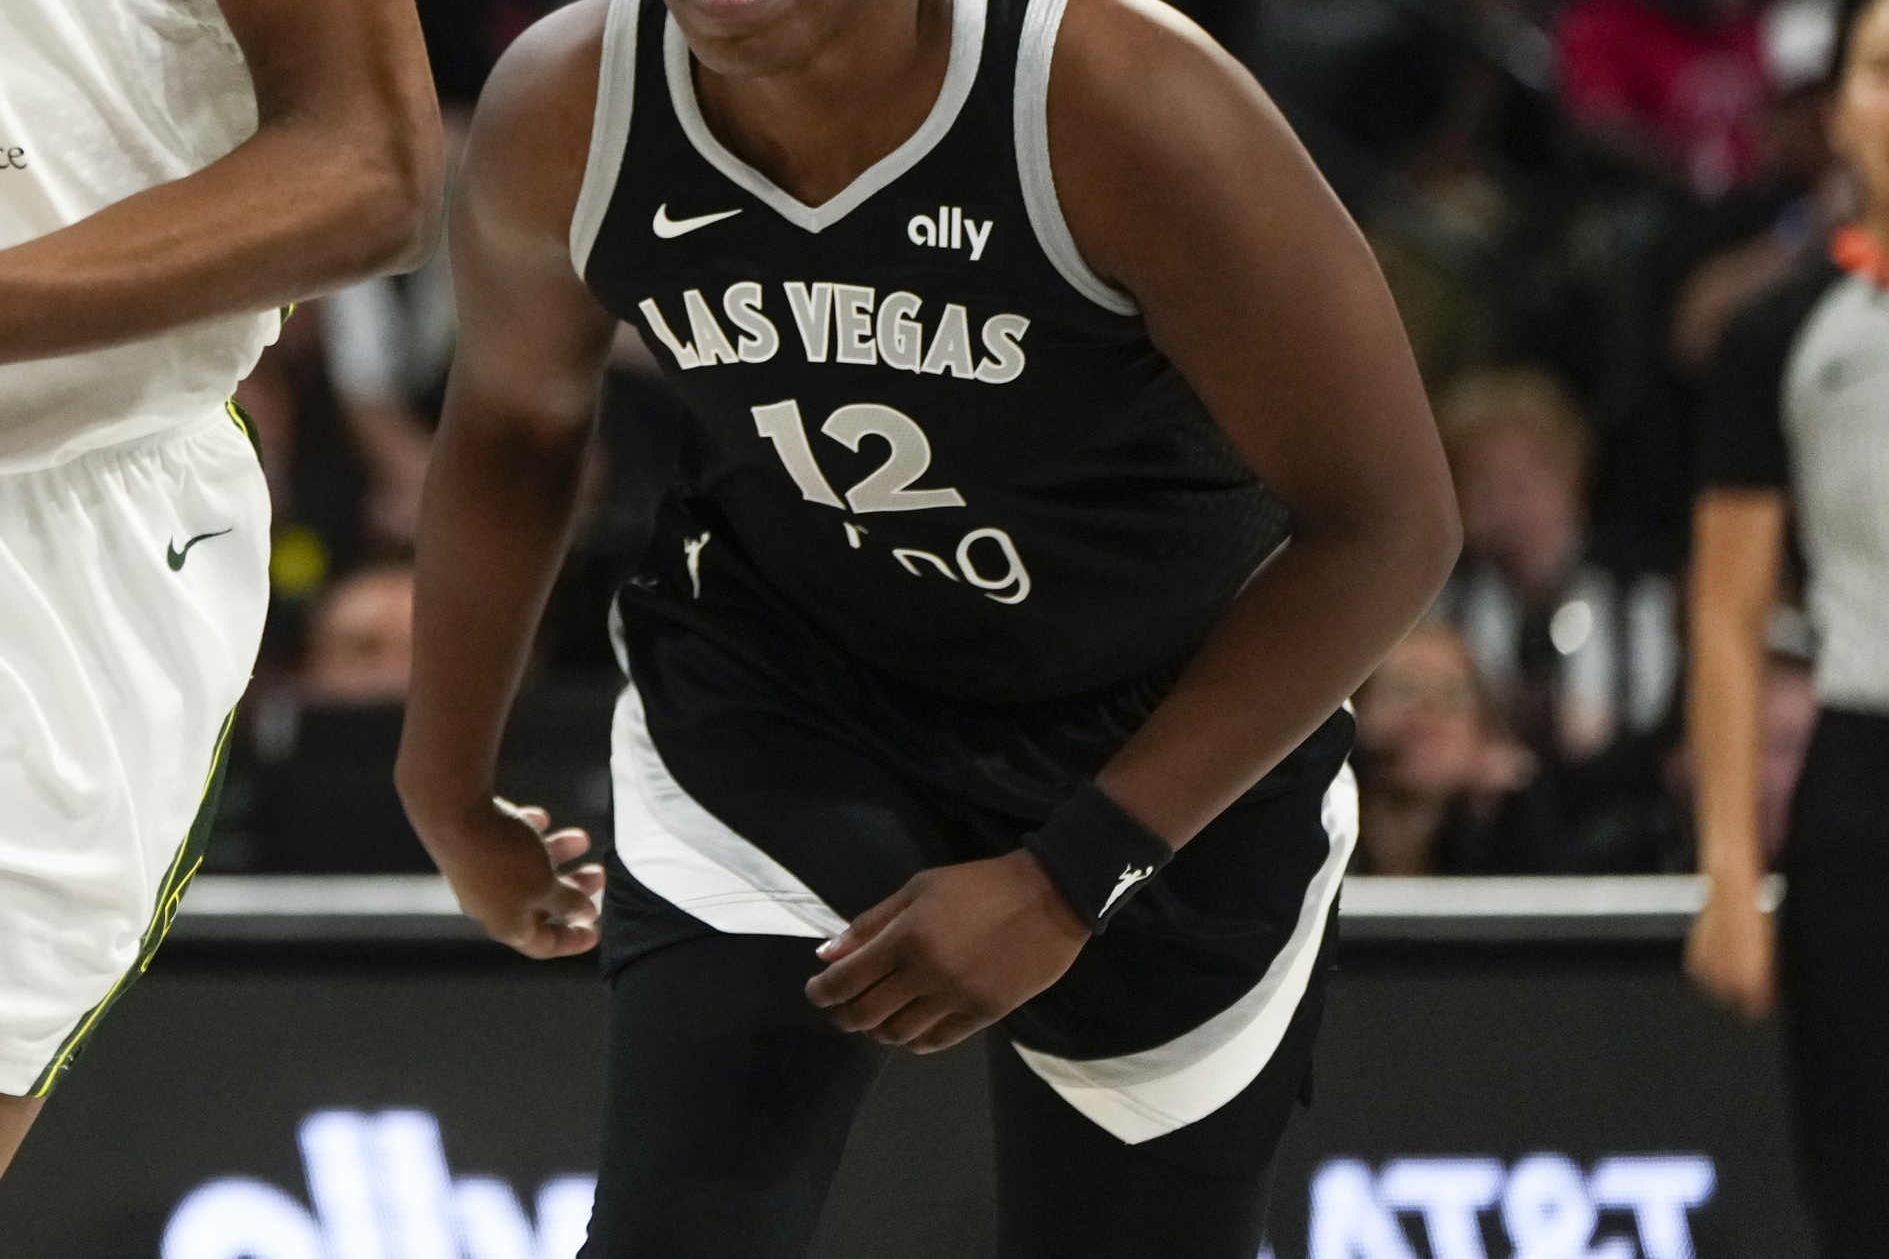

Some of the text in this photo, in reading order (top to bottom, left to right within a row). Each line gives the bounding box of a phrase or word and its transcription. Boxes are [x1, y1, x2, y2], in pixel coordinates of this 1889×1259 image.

[907, 205, 994, 261] ally
[638, 281, 1031, 384] LAS VEGAS
[750, 399, 967, 515] 12
